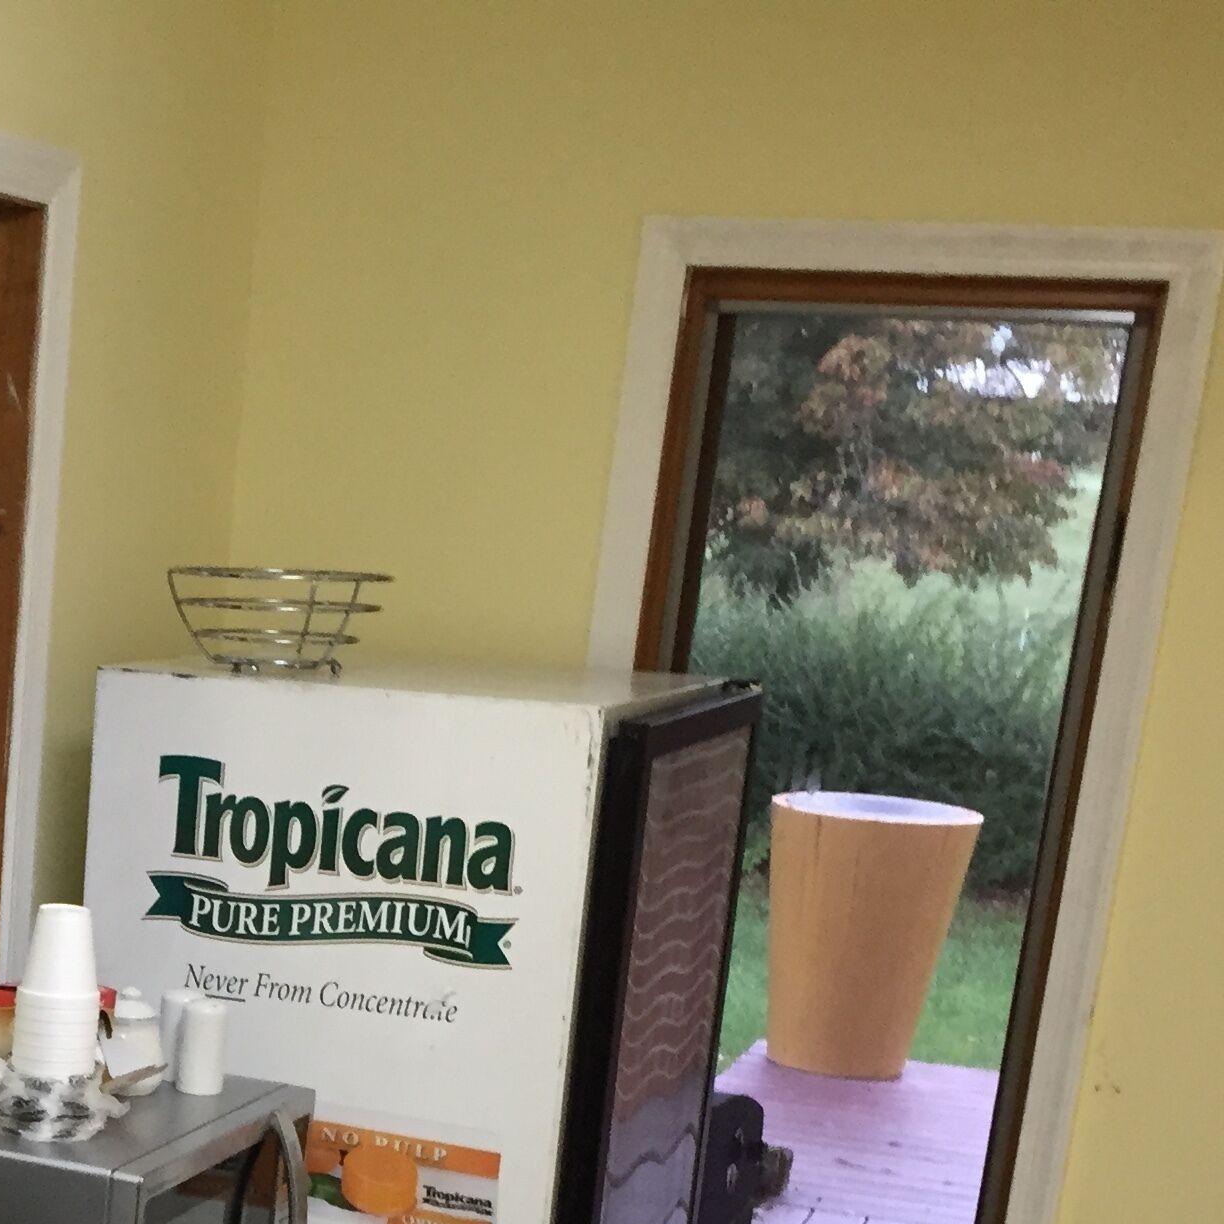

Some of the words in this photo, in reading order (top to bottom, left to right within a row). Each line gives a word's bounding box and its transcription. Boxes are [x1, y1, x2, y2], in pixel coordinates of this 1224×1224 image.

[159, 755, 514, 890] Tropicana
[188, 894, 280, 936] PURE
[288, 899, 470, 948] PREMIUM
[184, 963, 249, 997] Never
[253, 972, 313, 1003] From
[321, 1127, 360, 1146] NO
[422, 1184, 493, 1209] Tropicana
